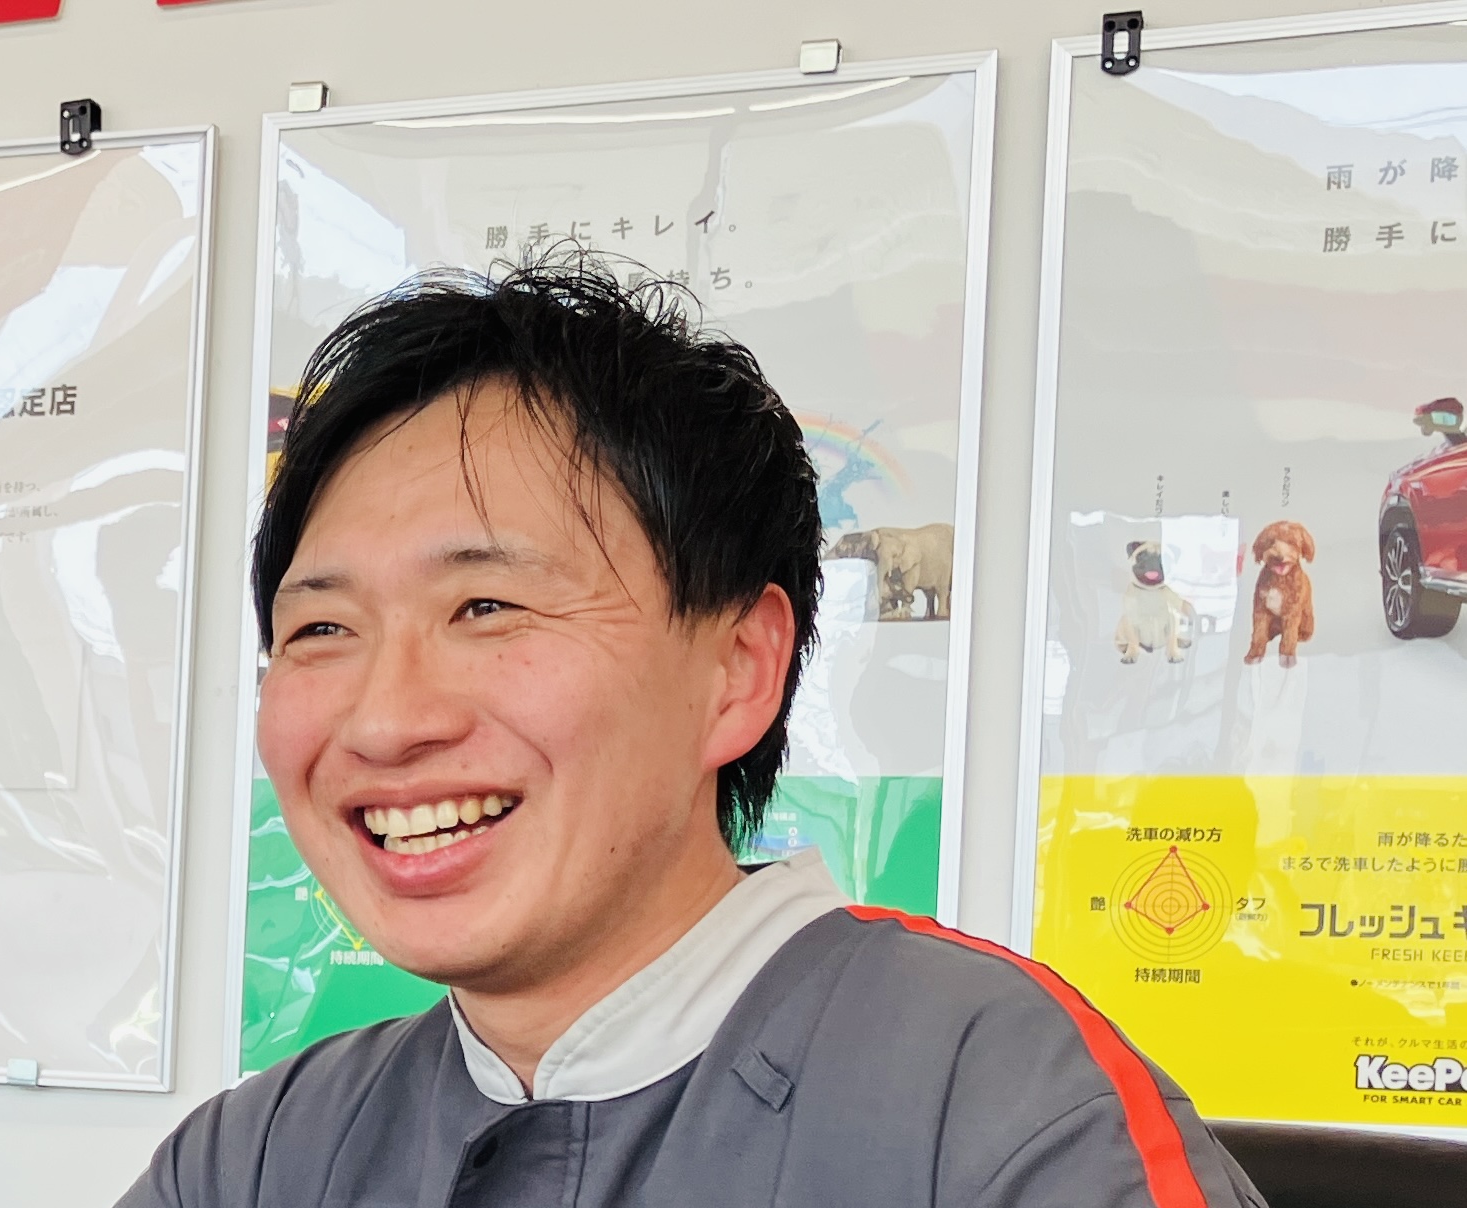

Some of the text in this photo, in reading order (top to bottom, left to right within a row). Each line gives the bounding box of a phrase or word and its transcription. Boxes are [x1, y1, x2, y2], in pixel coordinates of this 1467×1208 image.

[485, 210, 737, 250] 勝手にキレイ。
[1322, 220, 1458, 253] 勝手に
[1126, 827, 1223, 842] 洗車の減り方
[1236, 897, 1266, 911] タフ
[1371, 948, 1467, 963] FRESH KEE
[1135, 968, 1201, 983] 持続期間
[1354, 1054, 1467, 1093] KeeP
[1363, 1094, 1462, 1105] FOR SMART CAR
